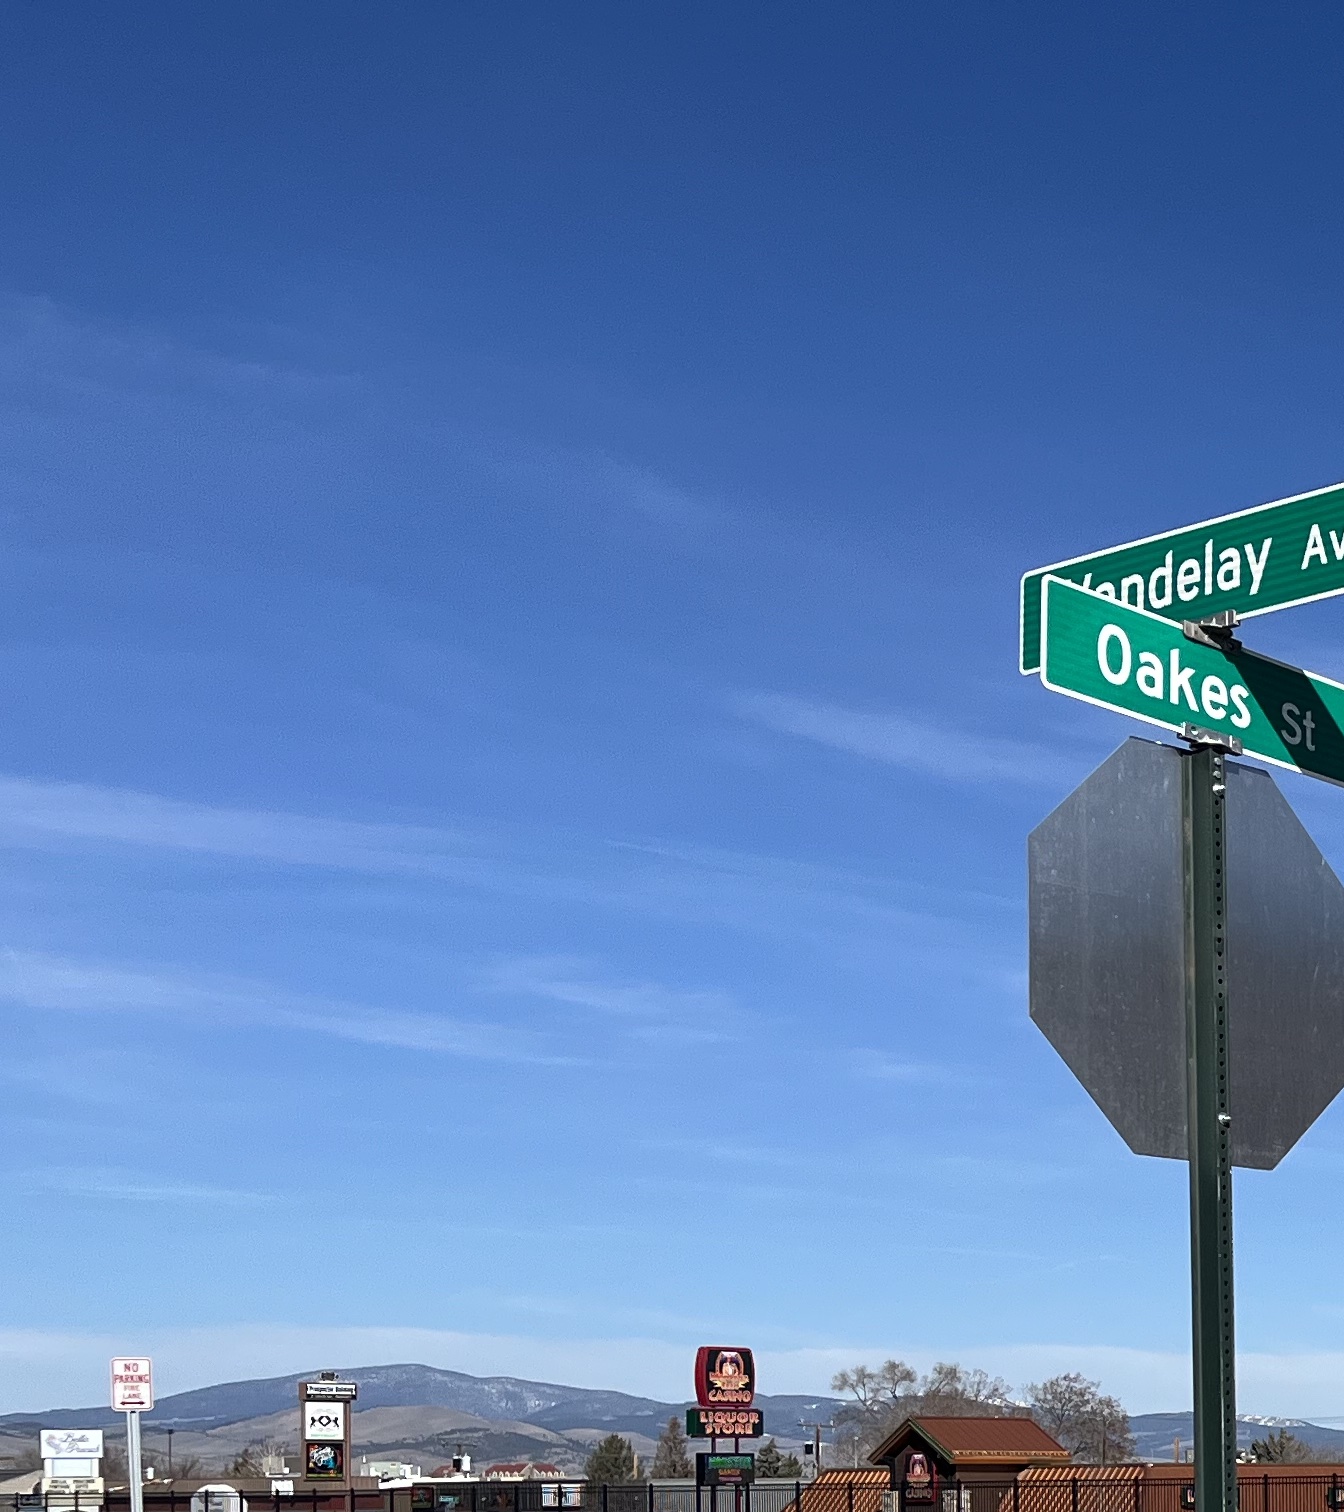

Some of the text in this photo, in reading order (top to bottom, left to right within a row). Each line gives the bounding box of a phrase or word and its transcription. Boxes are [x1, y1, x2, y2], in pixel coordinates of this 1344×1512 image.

[1064, 537, 1273, 611] ndelay
[1097, 623, 1316, 751] Oakes St
[124, 1362, 139, 1373] NO
[113, 1374, 150, 1384] PARKING
[708, 1389, 752, 1403] CASINO
[699, 1411, 760, 1424] LIQUOR
[705, 1423, 754, 1435] STORE
